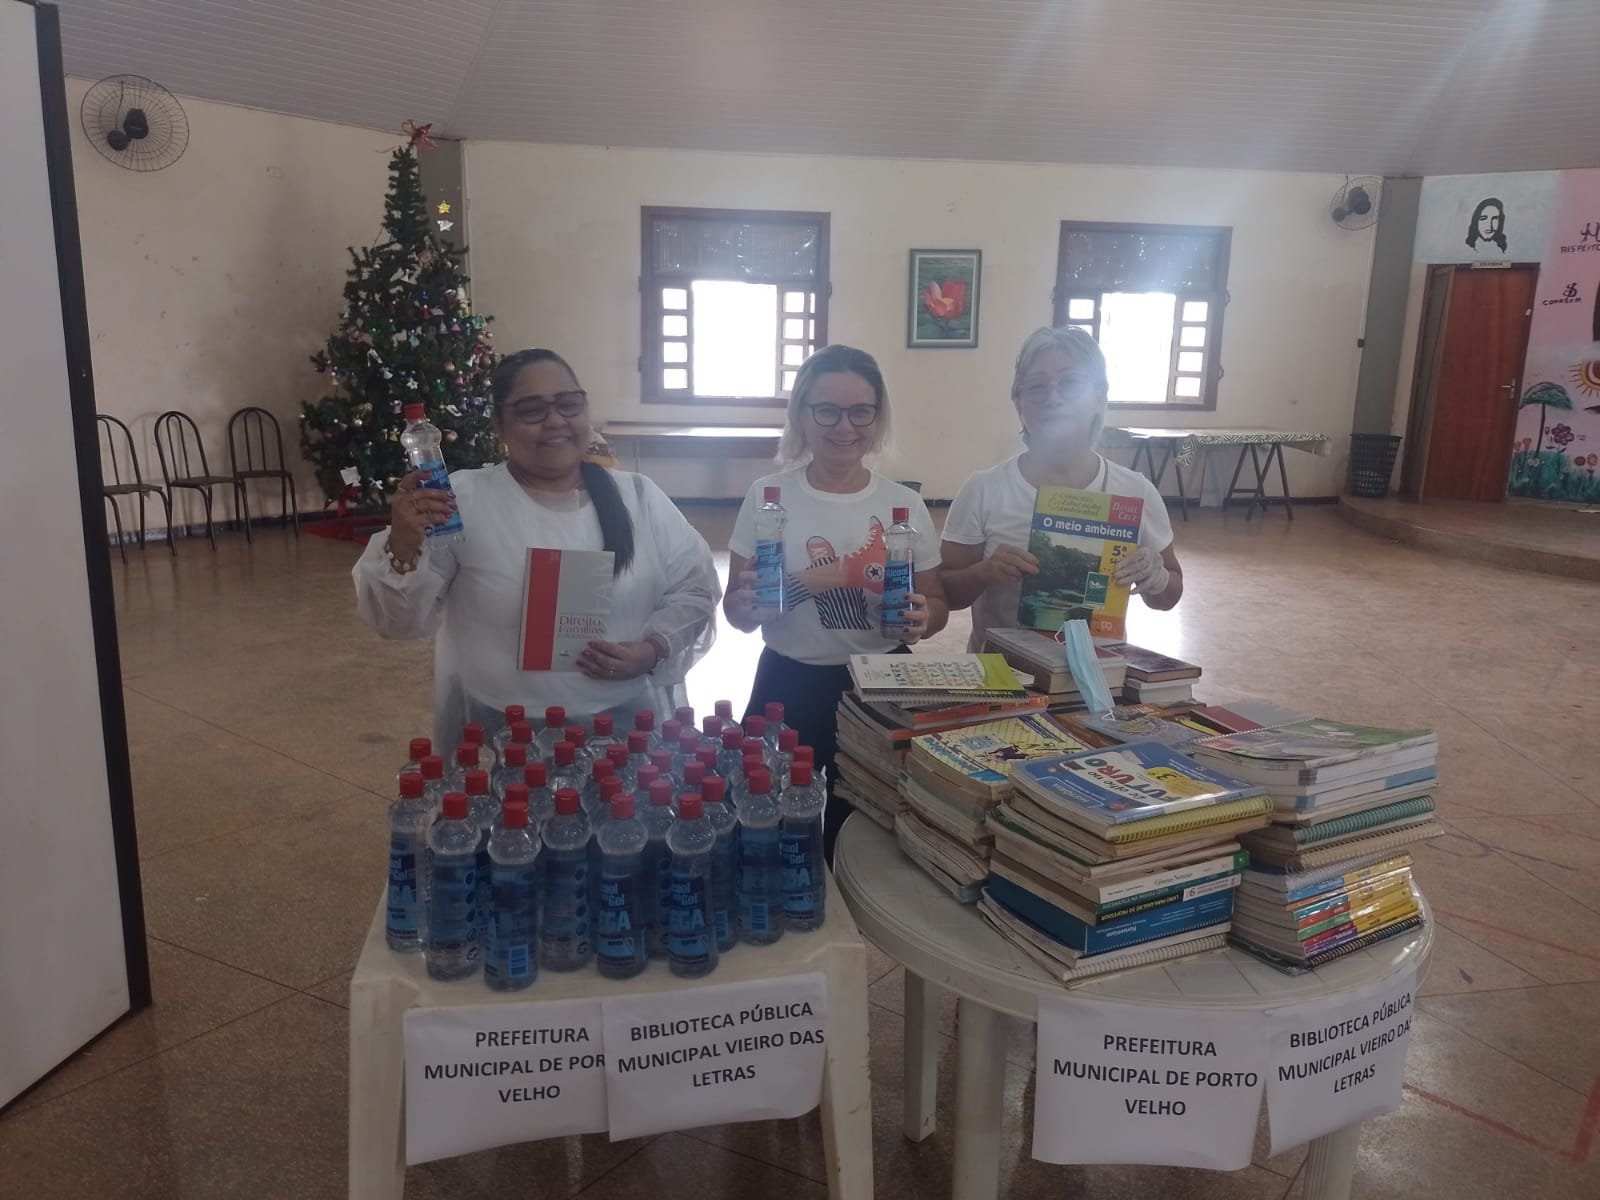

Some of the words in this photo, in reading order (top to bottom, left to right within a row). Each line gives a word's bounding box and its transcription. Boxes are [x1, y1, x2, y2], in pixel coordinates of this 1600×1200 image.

[1043, 517, 1053, 528] O
[1055, 520, 1082, 532] meio
[1084, 523, 1134, 540] ambiente
[1087, 770, 1104, 781] no
[630, 1013, 735, 1041] BIBLIOTECA
[740, 1001, 813, 1025] PÚBLICA
[1290, 1016, 1369, 1048] BIBLIOTECA
[1372, 992, 1411, 1024] PÚBLICA
[475, 1027, 589, 1048] PREFEITURA
[1103, 1034, 1217, 1057] PREFEITURA
[1278, 1047, 1357, 1082] MUNICIPAL
[1360, 1032, 1395, 1059] VIEIRO
[1397, 1017, 1412, 1038] DA
[618, 1044, 721, 1074] MUNICIPAL
[725, 1031, 785, 1055] VIEIRO
[789, 1029, 824, 1046] DAS
[425, 1059, 534, 1080] MUNICIPAL
[539, 1057, 564, 1073] DE
[569, 1053, 606, 1070] POR
[693, 1065, 756, 1087] LETRAS
[1053, 1059, 1160, 1086] MUNICIPAL
[1166, 1070, 1190, 1086] DE
[1195, 1071, 1258, 1088] PORTO
[1333, 1063, 1376, 1094] LETRAS
[498, 1084, 561, 1103] VELHO
[1125, 1098, 1186, 1116] VELHO
